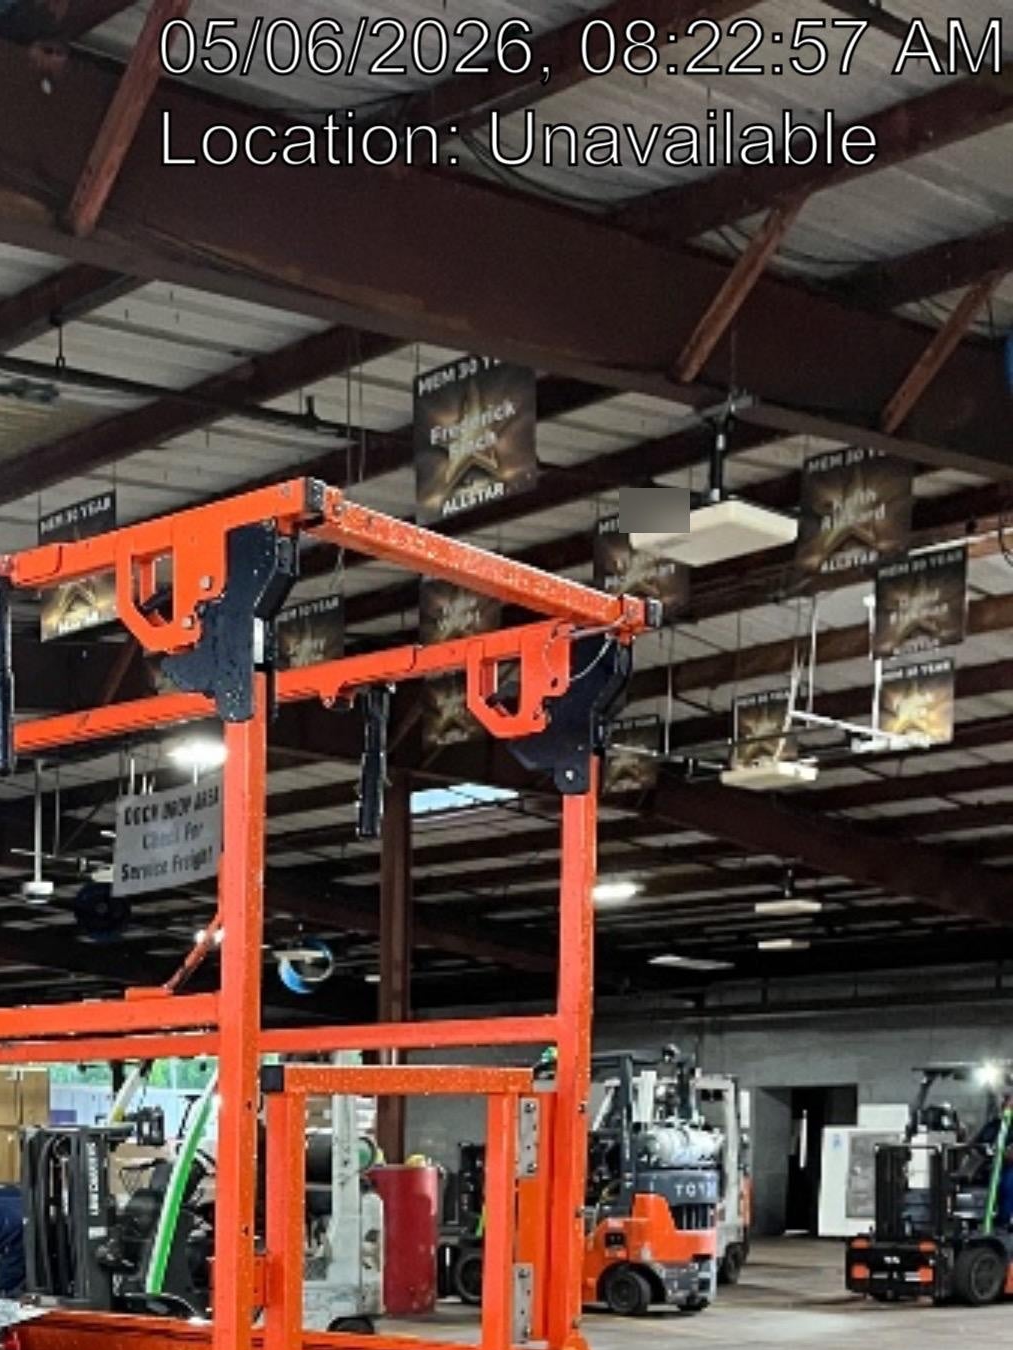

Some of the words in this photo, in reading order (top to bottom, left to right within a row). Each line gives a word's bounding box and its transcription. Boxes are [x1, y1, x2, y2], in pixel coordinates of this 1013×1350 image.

[418, 367, 456, 396] MEM
[458, 359, 478, 380] 30
[442, 482, 505, 518] ALLSTAR
